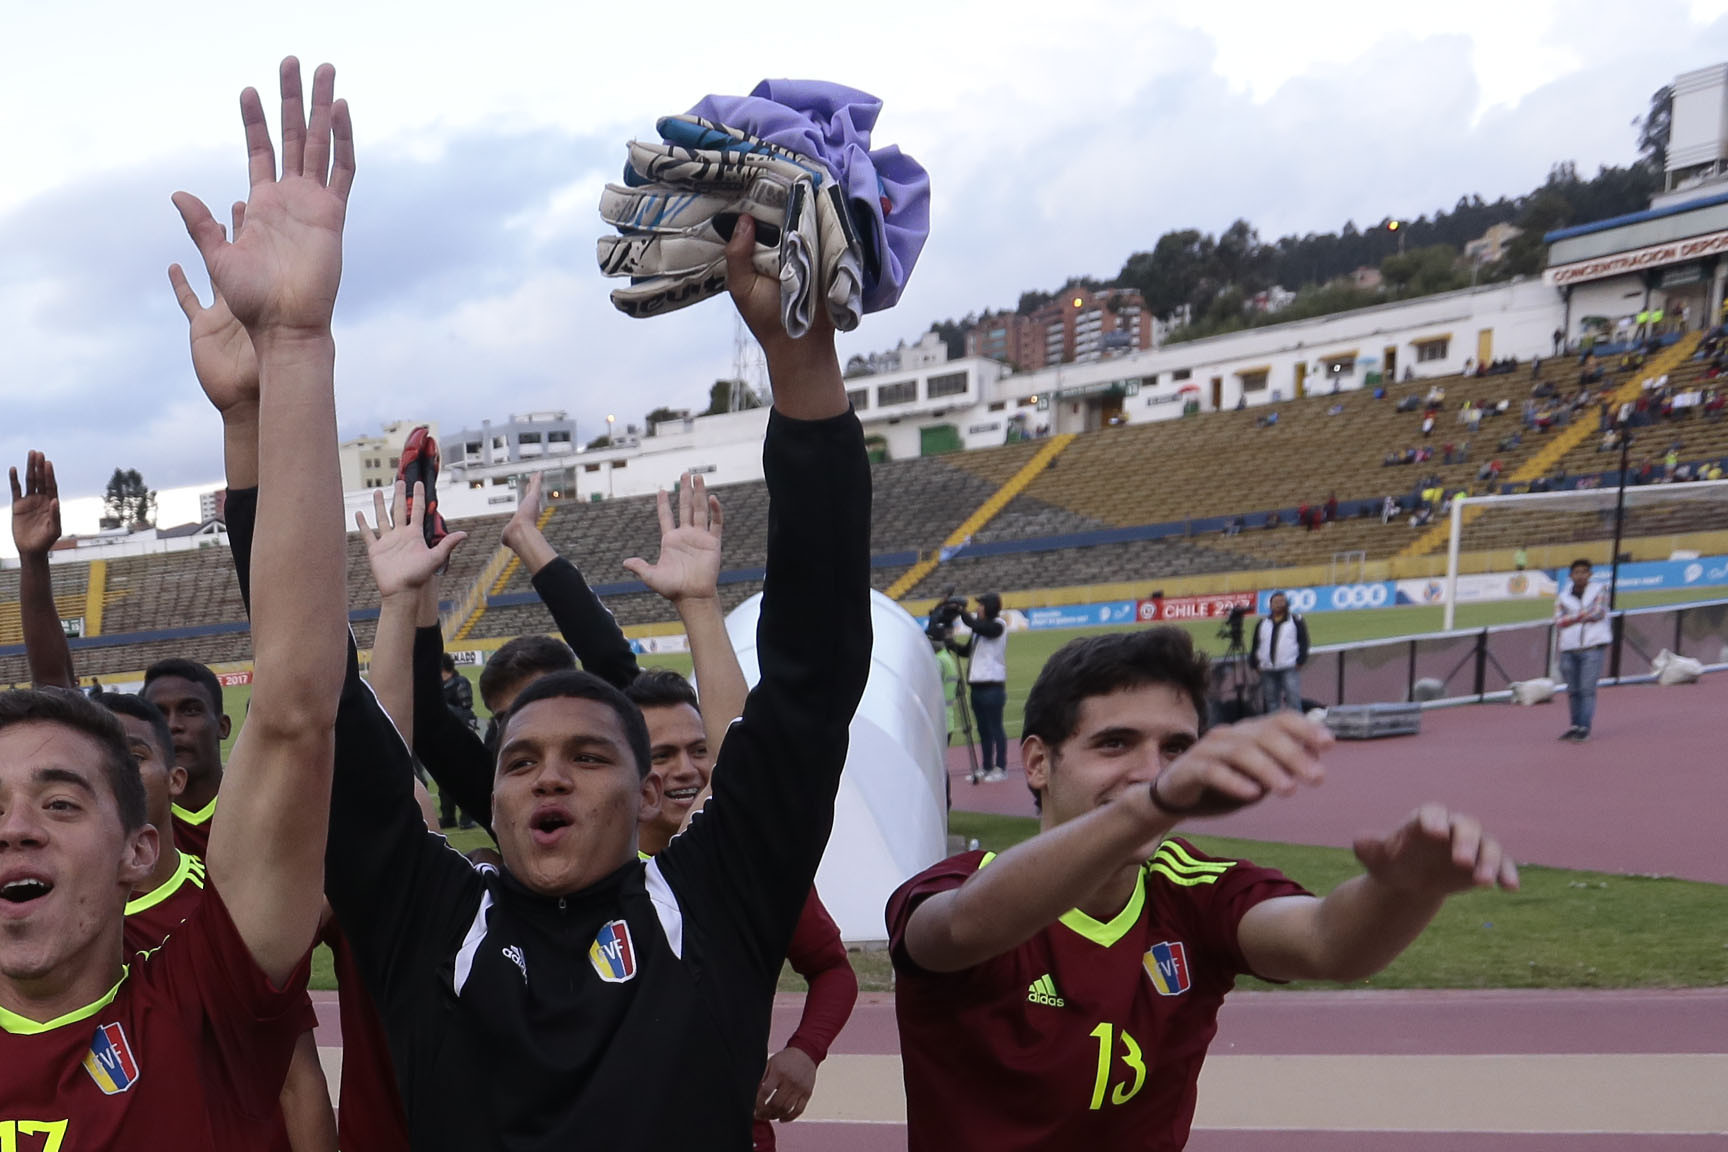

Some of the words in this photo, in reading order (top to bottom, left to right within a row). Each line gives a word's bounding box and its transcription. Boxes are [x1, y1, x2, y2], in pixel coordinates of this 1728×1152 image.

[1164, 602, 1209, 618] CHILE
[225, 676, 248, 686] 2017
[1027, 992, 1064, 1008] didas
[1089, 1022, 1146, 1110] 13
